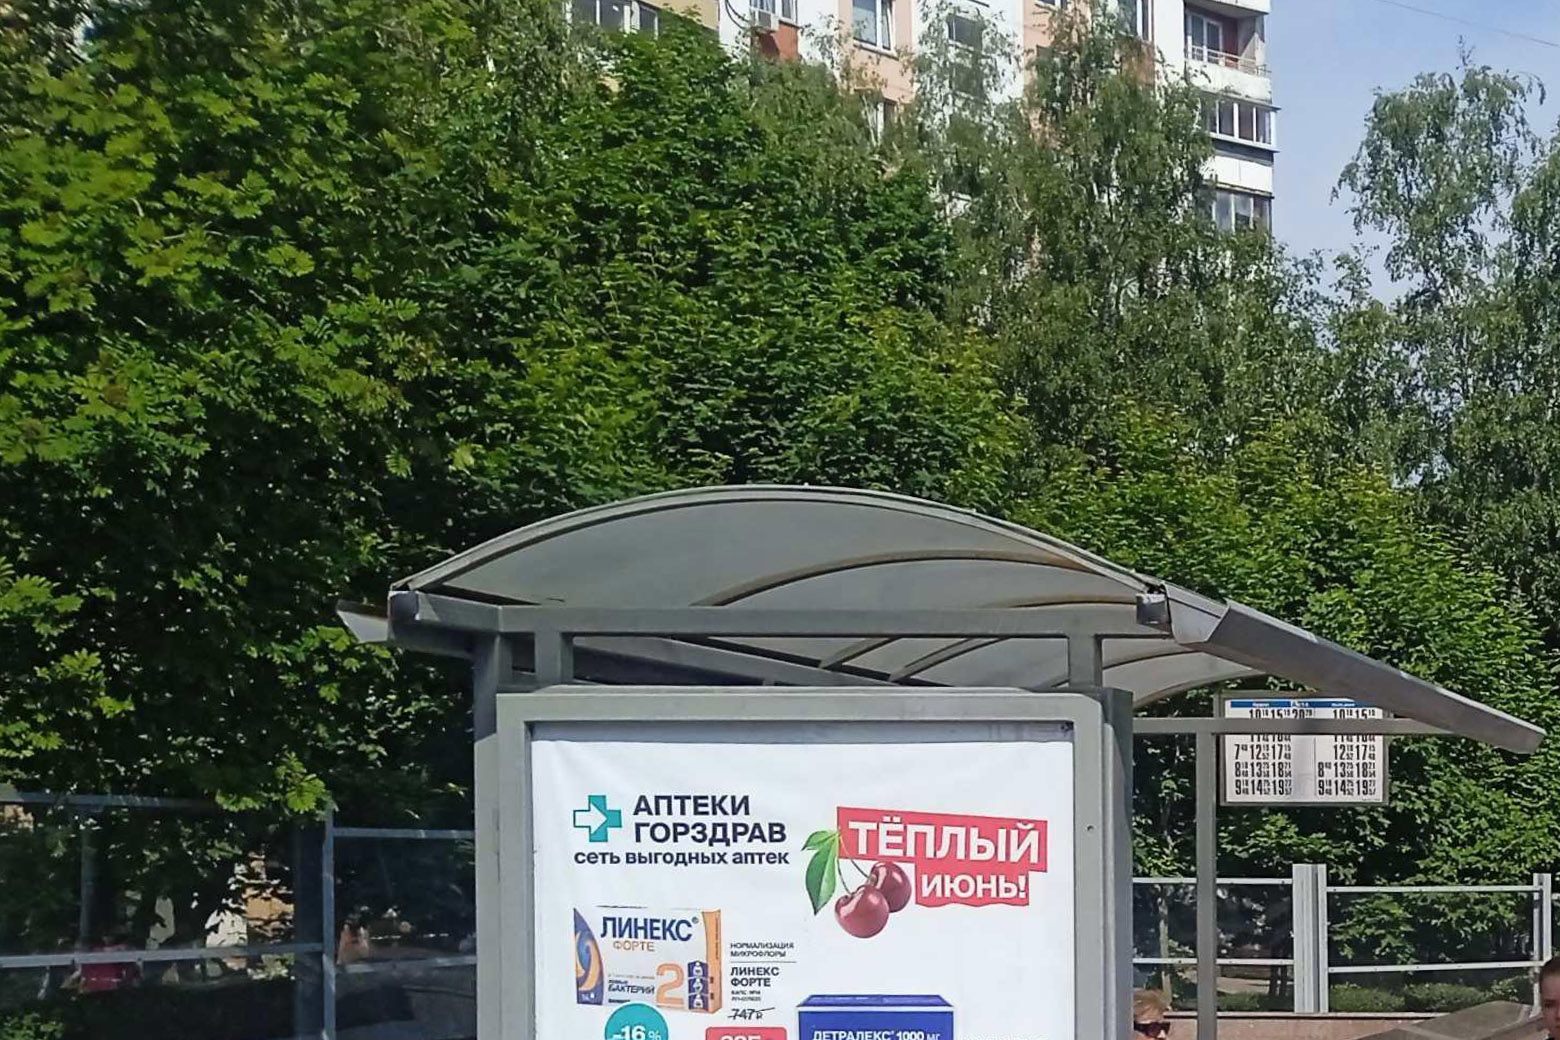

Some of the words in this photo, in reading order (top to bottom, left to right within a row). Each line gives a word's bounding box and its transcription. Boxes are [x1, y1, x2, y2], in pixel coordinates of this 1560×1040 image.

[1234, 744, 1240, 760] 7
[1250, 744, 1262, 760] 12
[1271, 744, 1283, 760] 17
[1333, 744, 1345, 760] 12
[1356, 744, 1367, 760] 17
[1235, 762, 1241, 777] 8
[1250, 762, 1262, 777] 13
[1271, 762, 1284, 777] 18
[1318, 762, 1324, 777] 8
[1334, 762, 1346, 777] 13
[1356, 762, 1368, 777] 18
[1235, 779, 1241, 795] 9
[1251, 779, 1262, 795] 14
[1272, 779, 1284, 795] 19
[1318, 779, 1324, 795] 9
[1335, 779, 1346, 795] 14
[1356, 779, 1368, 795] 19
[633, 795, 750, 816] АПТЕКИ
[635, 822, 787, 847] ГОРЗДРАВ
[848, 816, 1040, 864] ТЁПЛЫЙ
[574, 851, 620, 865] сеть
[625, 851, 727, 867] выгодных
[731, 851, 789, 865] аптек
[921, 873, 1027, 899] ИЮНЬ!
[613, 940, 655, 952] ФОРТЕ
[730, 966, 780, 976] ЛИНЕКС
[730, 977, 771, 987] ФОРТЕ
